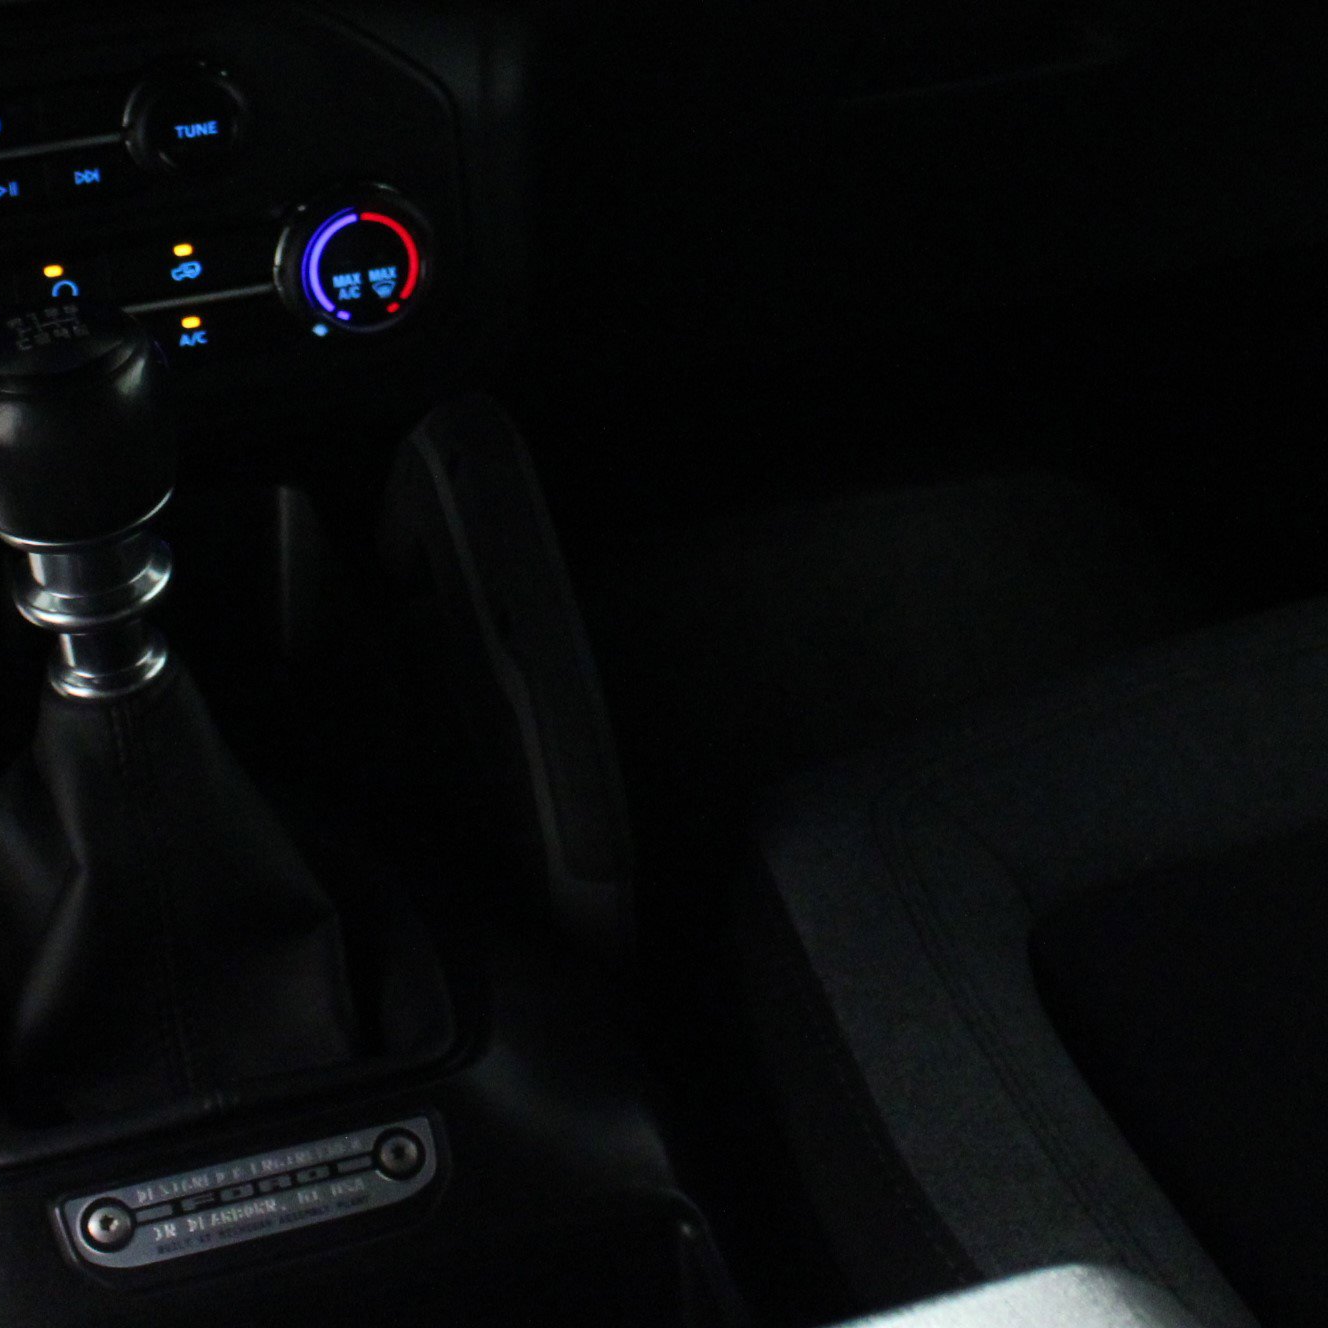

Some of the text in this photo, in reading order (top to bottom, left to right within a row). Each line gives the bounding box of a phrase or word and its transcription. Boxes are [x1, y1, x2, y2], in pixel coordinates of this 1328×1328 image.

[174, 120, 219, 139] TUNE
[332, 272, 362, 289] MAX
[368, 265, 398, 283] MAX
[338, 284, 362, 301] A/C
[179, 328, 208, 347] A/C
[180, 1164, 331, 1212] FORD
